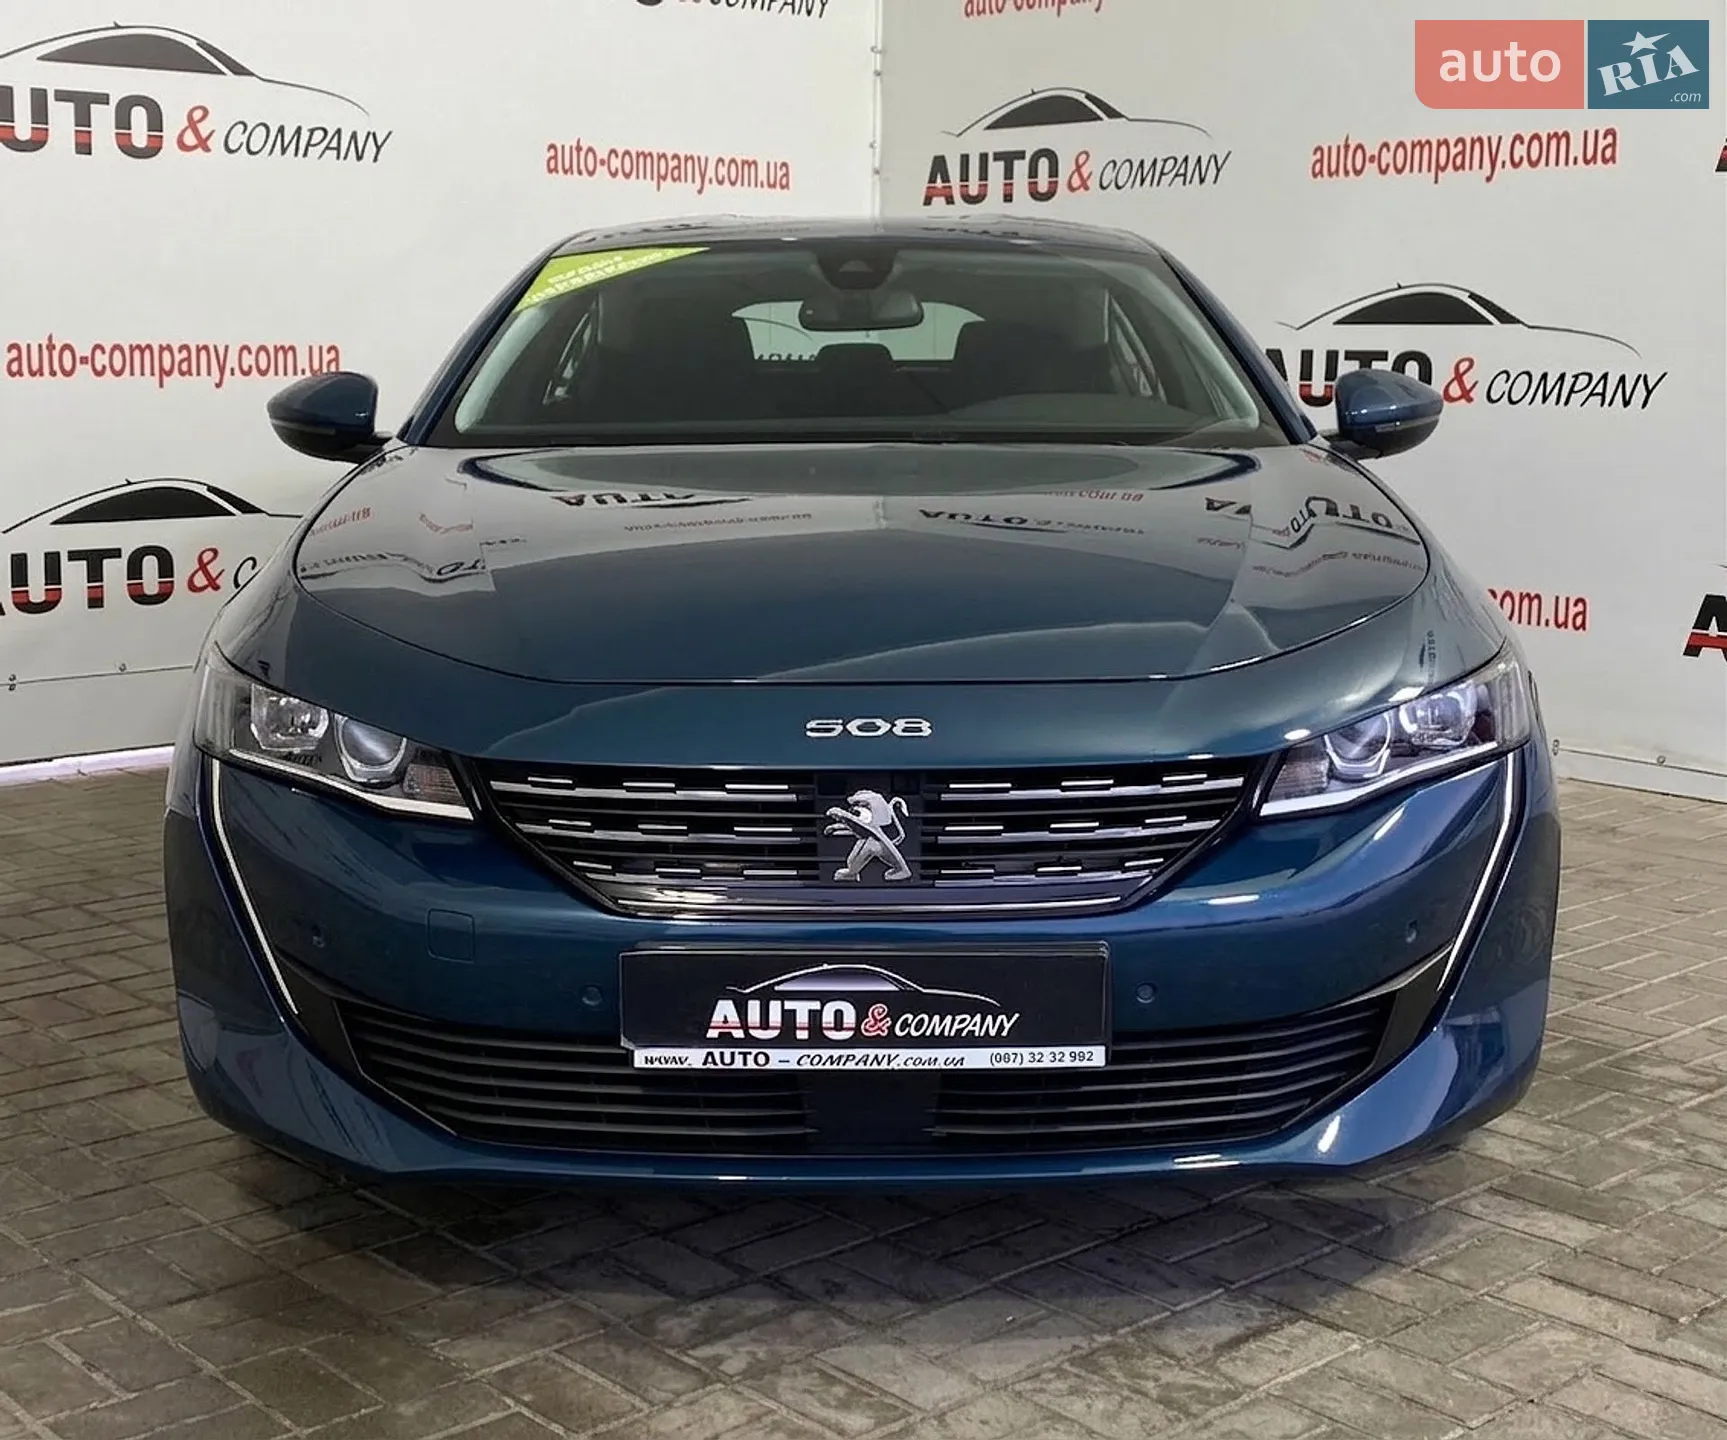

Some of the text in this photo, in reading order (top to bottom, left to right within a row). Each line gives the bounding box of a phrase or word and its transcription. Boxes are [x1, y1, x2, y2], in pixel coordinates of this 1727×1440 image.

[0, 85, 392, 164] UTO & COMPANY
[546, 138, 791, 194] auto-company.com.ua
[922, 148, 1232, 206] AUTO & COMPANY
[1311, 127, 1618, 184] auto-company.com.ua
[5, 334, 341, 388] auto-company.com.ua
[1443, 357, 1479, 403] &
[1486, 369, 1668, 410] COMPANY
[0, 545, 175, 616] UTO
[186, 547, 226, 593] &
[1487, 588, 1587, 631] om.ua
[805, 718, 932, 738] 508
[705, 999, 1021, 1041] AUTO & COMPANY
[702, 1051, 771, 1068] AUTO
[1028, 1051, 1045, 1063] 32
[1049, 1050, 1066, 1063] 32
